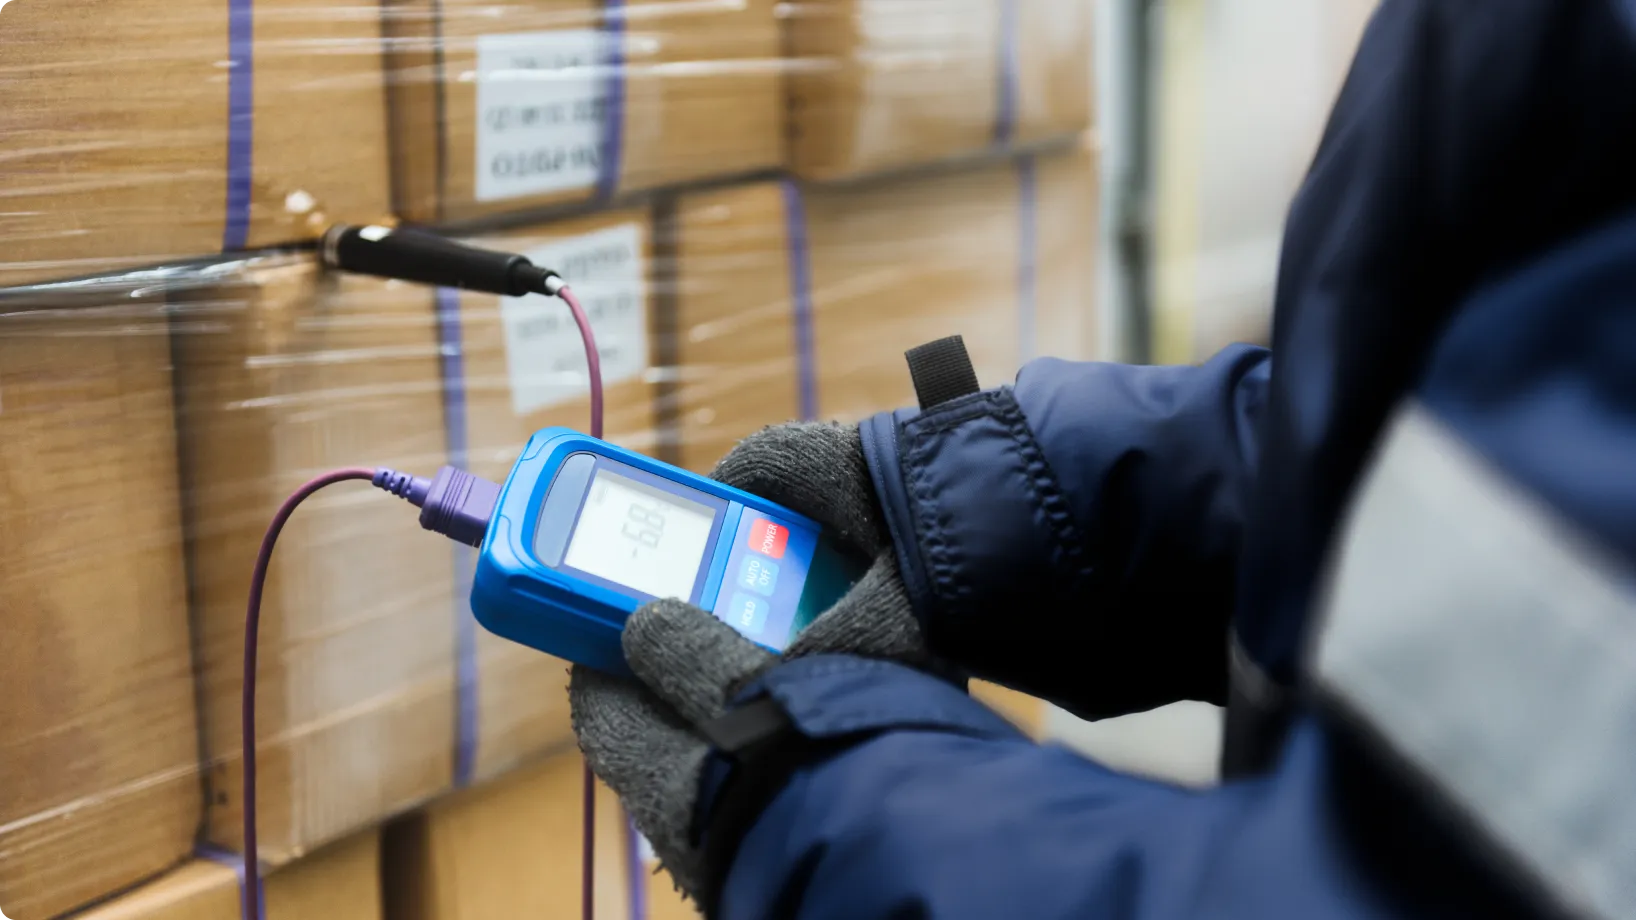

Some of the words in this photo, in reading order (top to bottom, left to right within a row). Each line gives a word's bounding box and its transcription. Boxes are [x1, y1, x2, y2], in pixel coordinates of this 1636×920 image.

[761, 523, 779, 554] POWER
[745, 560, 760, 587] AUTO
[759, 568, 771, 586] OFF
[741, 600, 756, 627] HOLD
